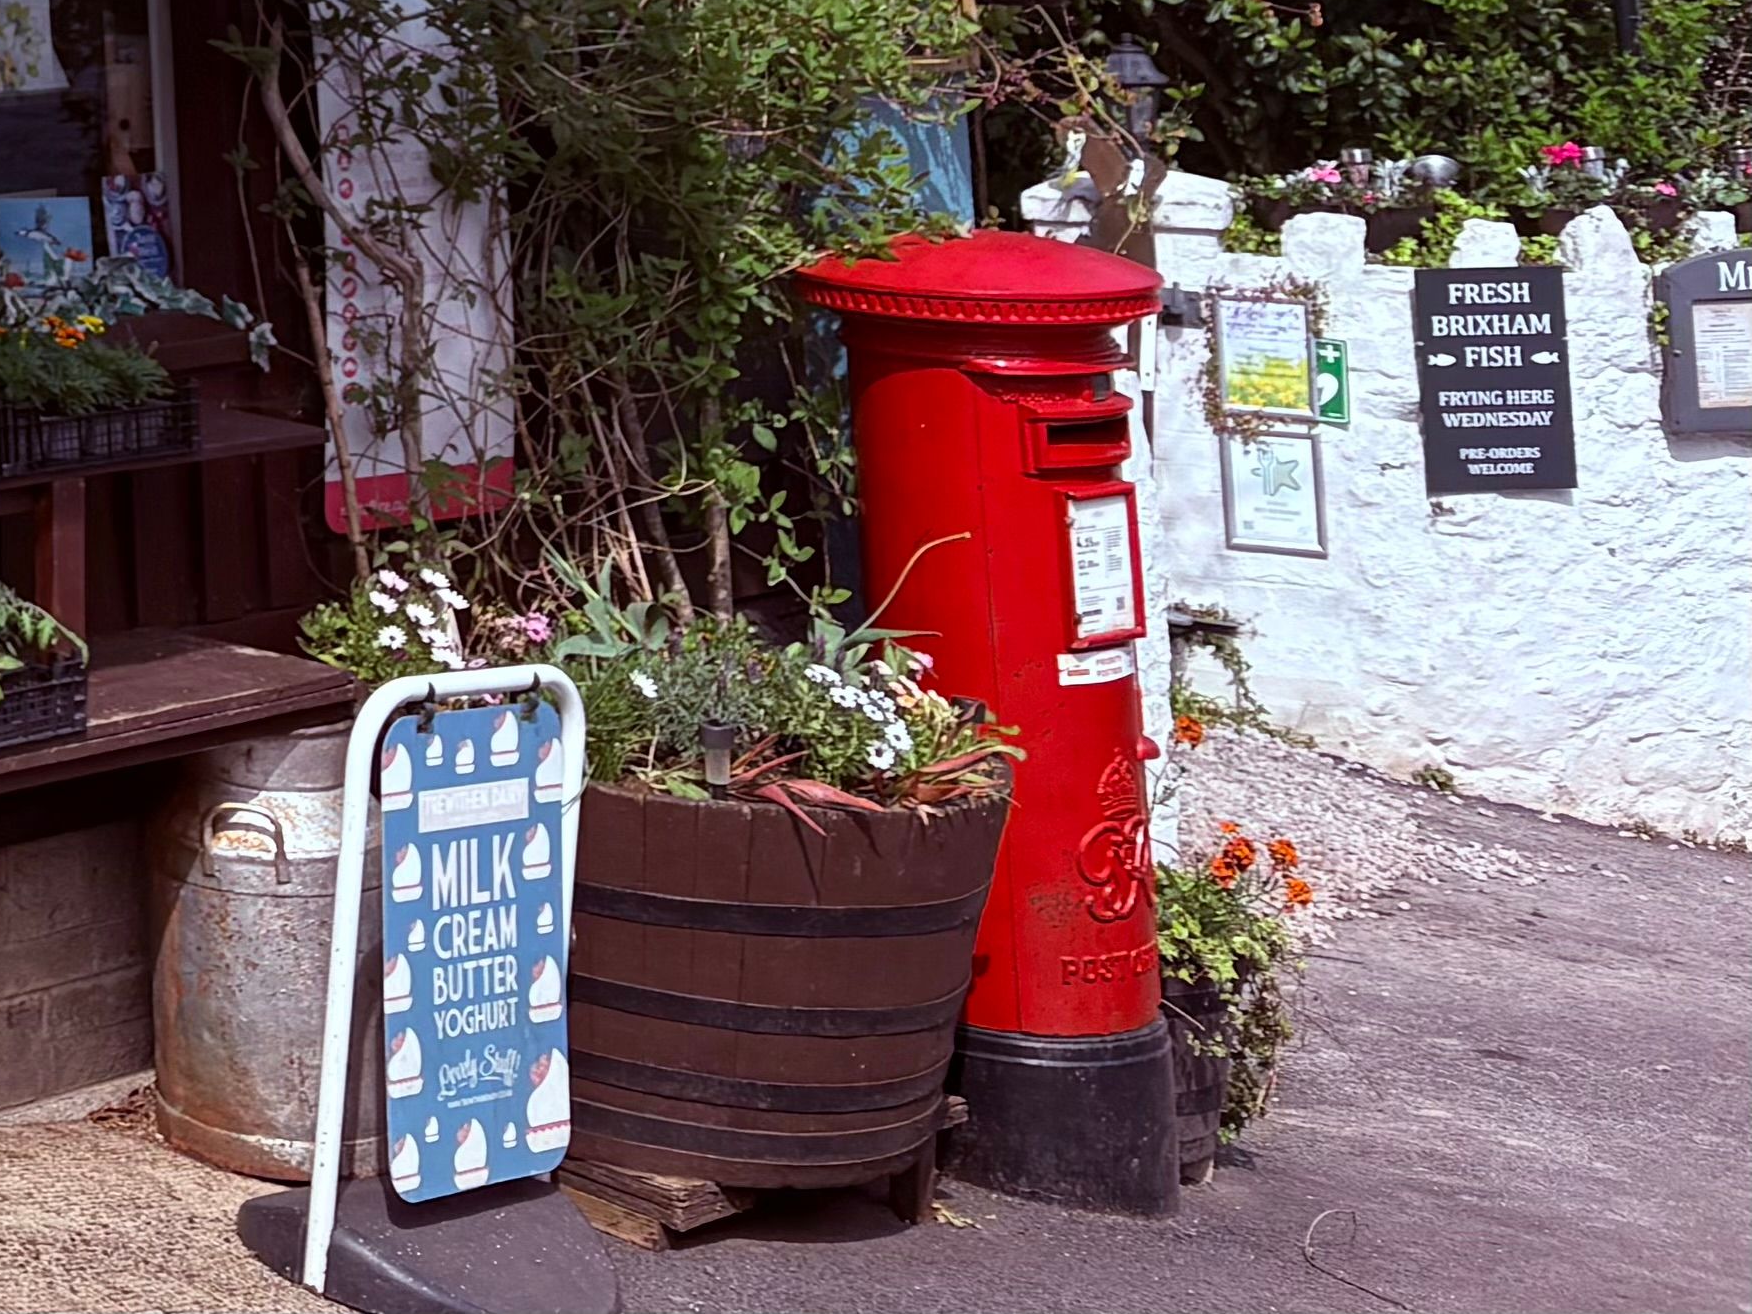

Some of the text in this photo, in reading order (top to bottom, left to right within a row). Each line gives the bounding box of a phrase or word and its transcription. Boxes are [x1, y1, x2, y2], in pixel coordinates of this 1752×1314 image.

[1448, 282, 1531, 305] FRESH
[1431, 314, 1552, 337] BRIXHAM
[1464, 345, 1523, 368] FISH
[1438, 389, 1555, 407] FRYING HERE
[1441, 411, 1553, 427] WEDNESDAY
[1459, 447, 1541, 460] PRE-ORDERS
[1467, 463, 1535, 475] WELCOME
[432, 832, 516, 911] MILK
[433, 904, 517, 959] CREAM
[433, 954, 518, 1005] BUTTER
[433, 997, 518, 1040] YOGHURT
